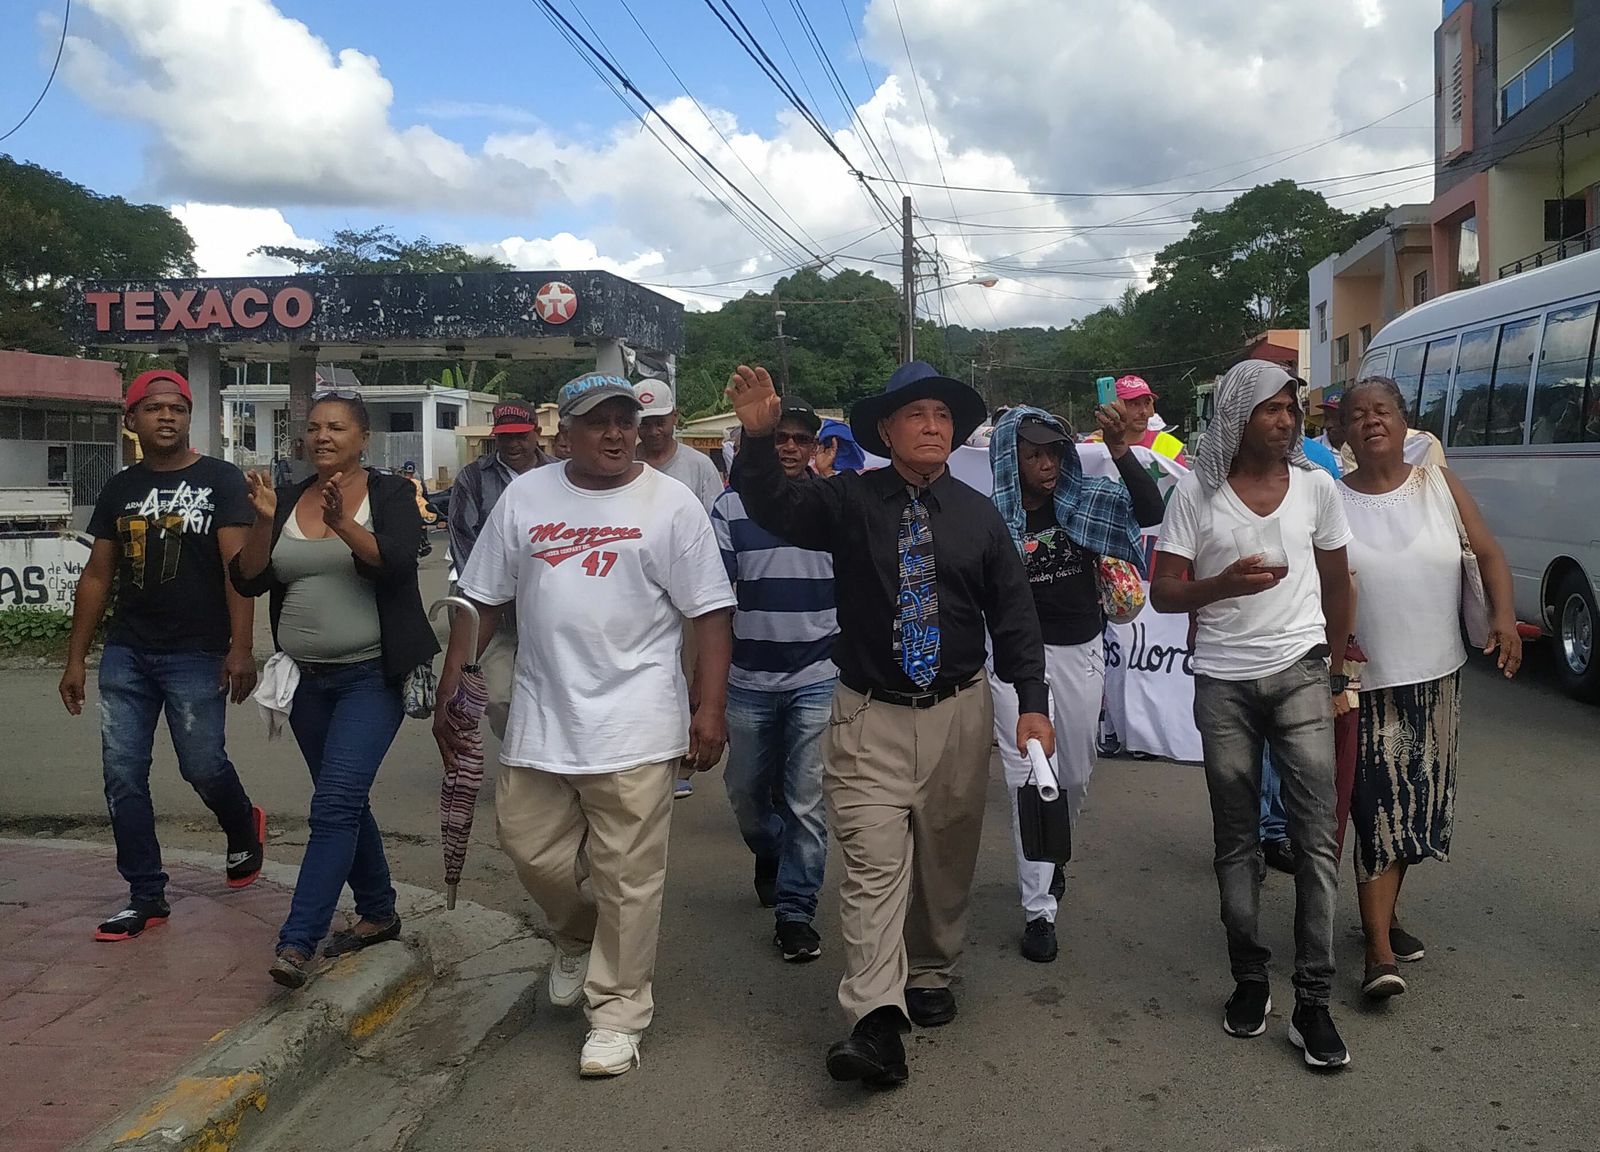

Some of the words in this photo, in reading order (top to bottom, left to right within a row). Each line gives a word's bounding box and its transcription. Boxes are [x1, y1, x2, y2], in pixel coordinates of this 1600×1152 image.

[85, 287, 313, 331] TEXACO
[47, 561, 62, 575] de
[581, 550, 619, 578] 47
[0, 565, 49, 605] AS
